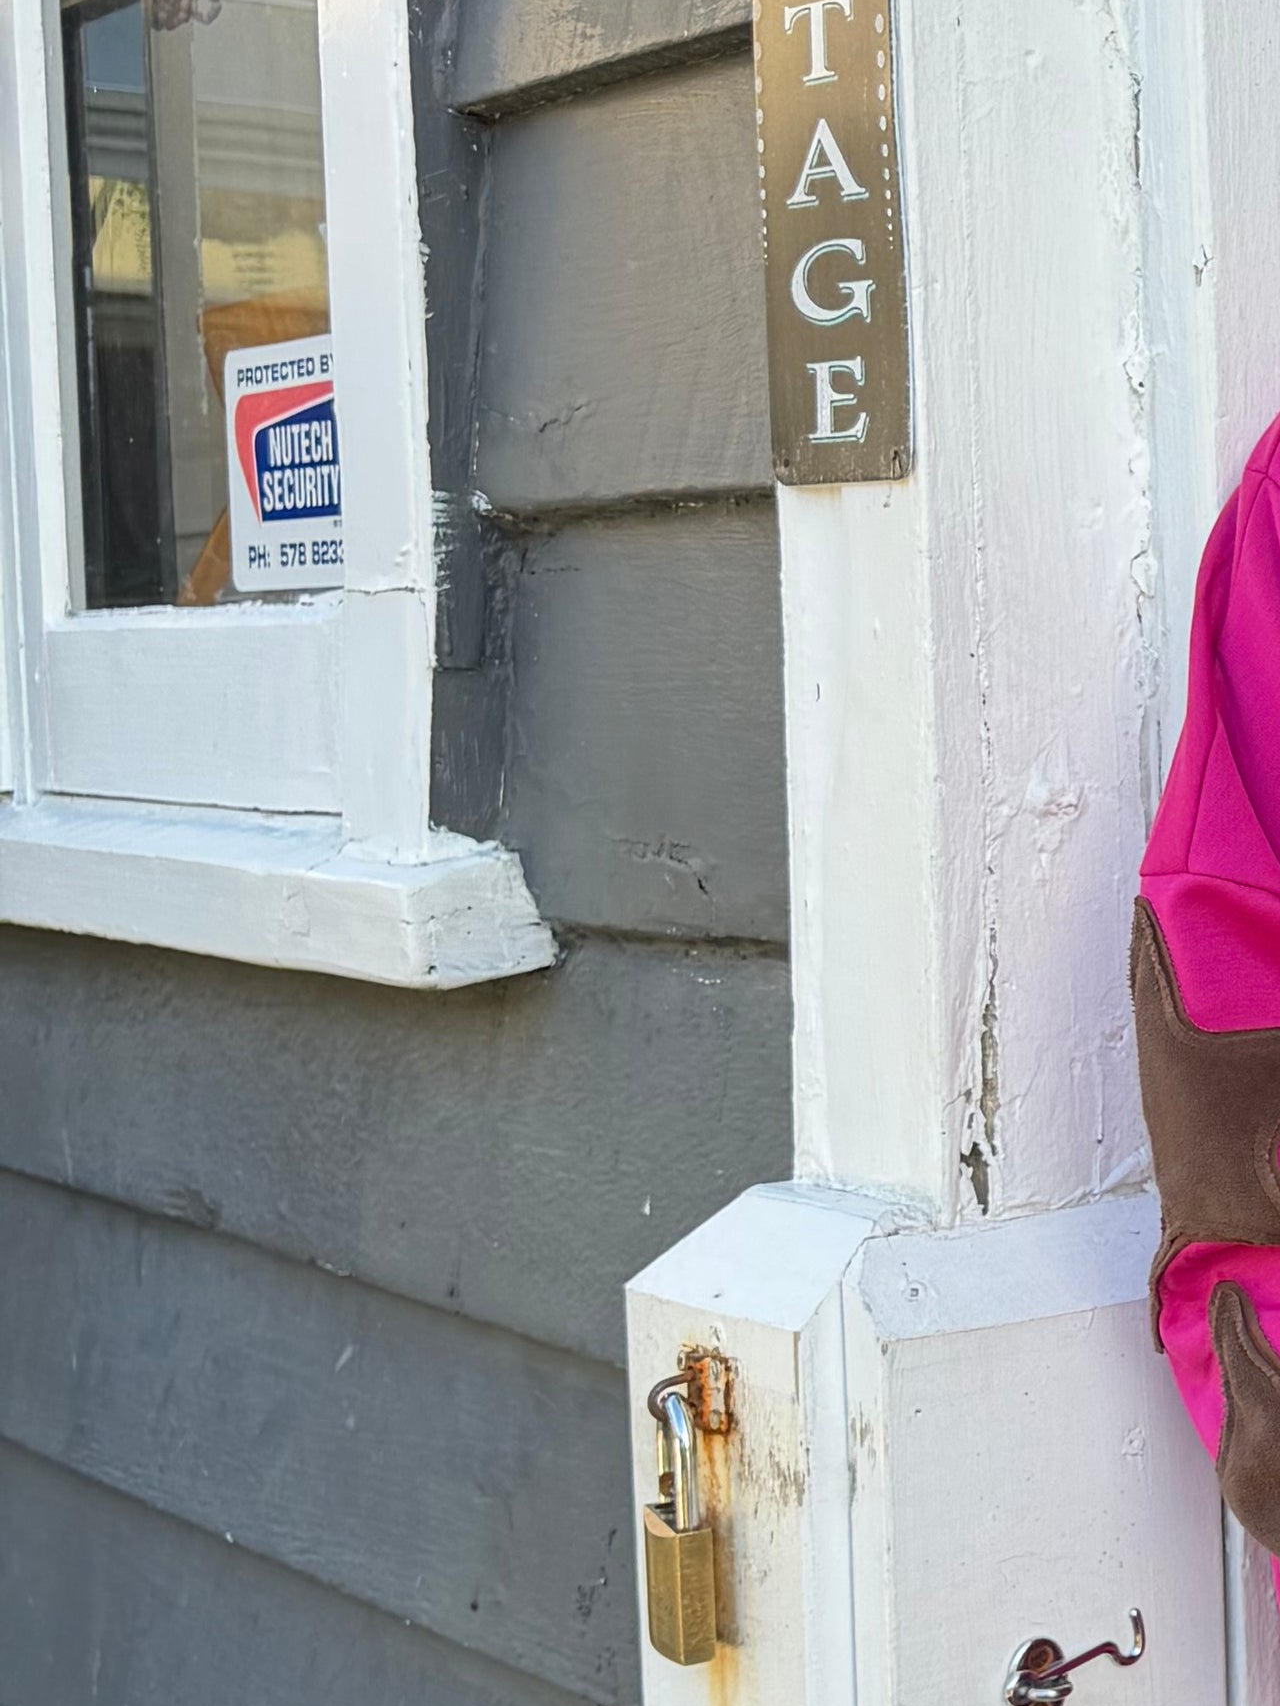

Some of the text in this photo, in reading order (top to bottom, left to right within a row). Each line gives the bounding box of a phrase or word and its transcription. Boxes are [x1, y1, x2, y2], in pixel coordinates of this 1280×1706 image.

[237, 357, 315, 387] PROTECTED
[268, 420, 333, 468] NUTECH
[262, 464, 340, 512] SECURITY
[248, 545, 271, 569] PH:
[280, 542, 307, 567] 578
